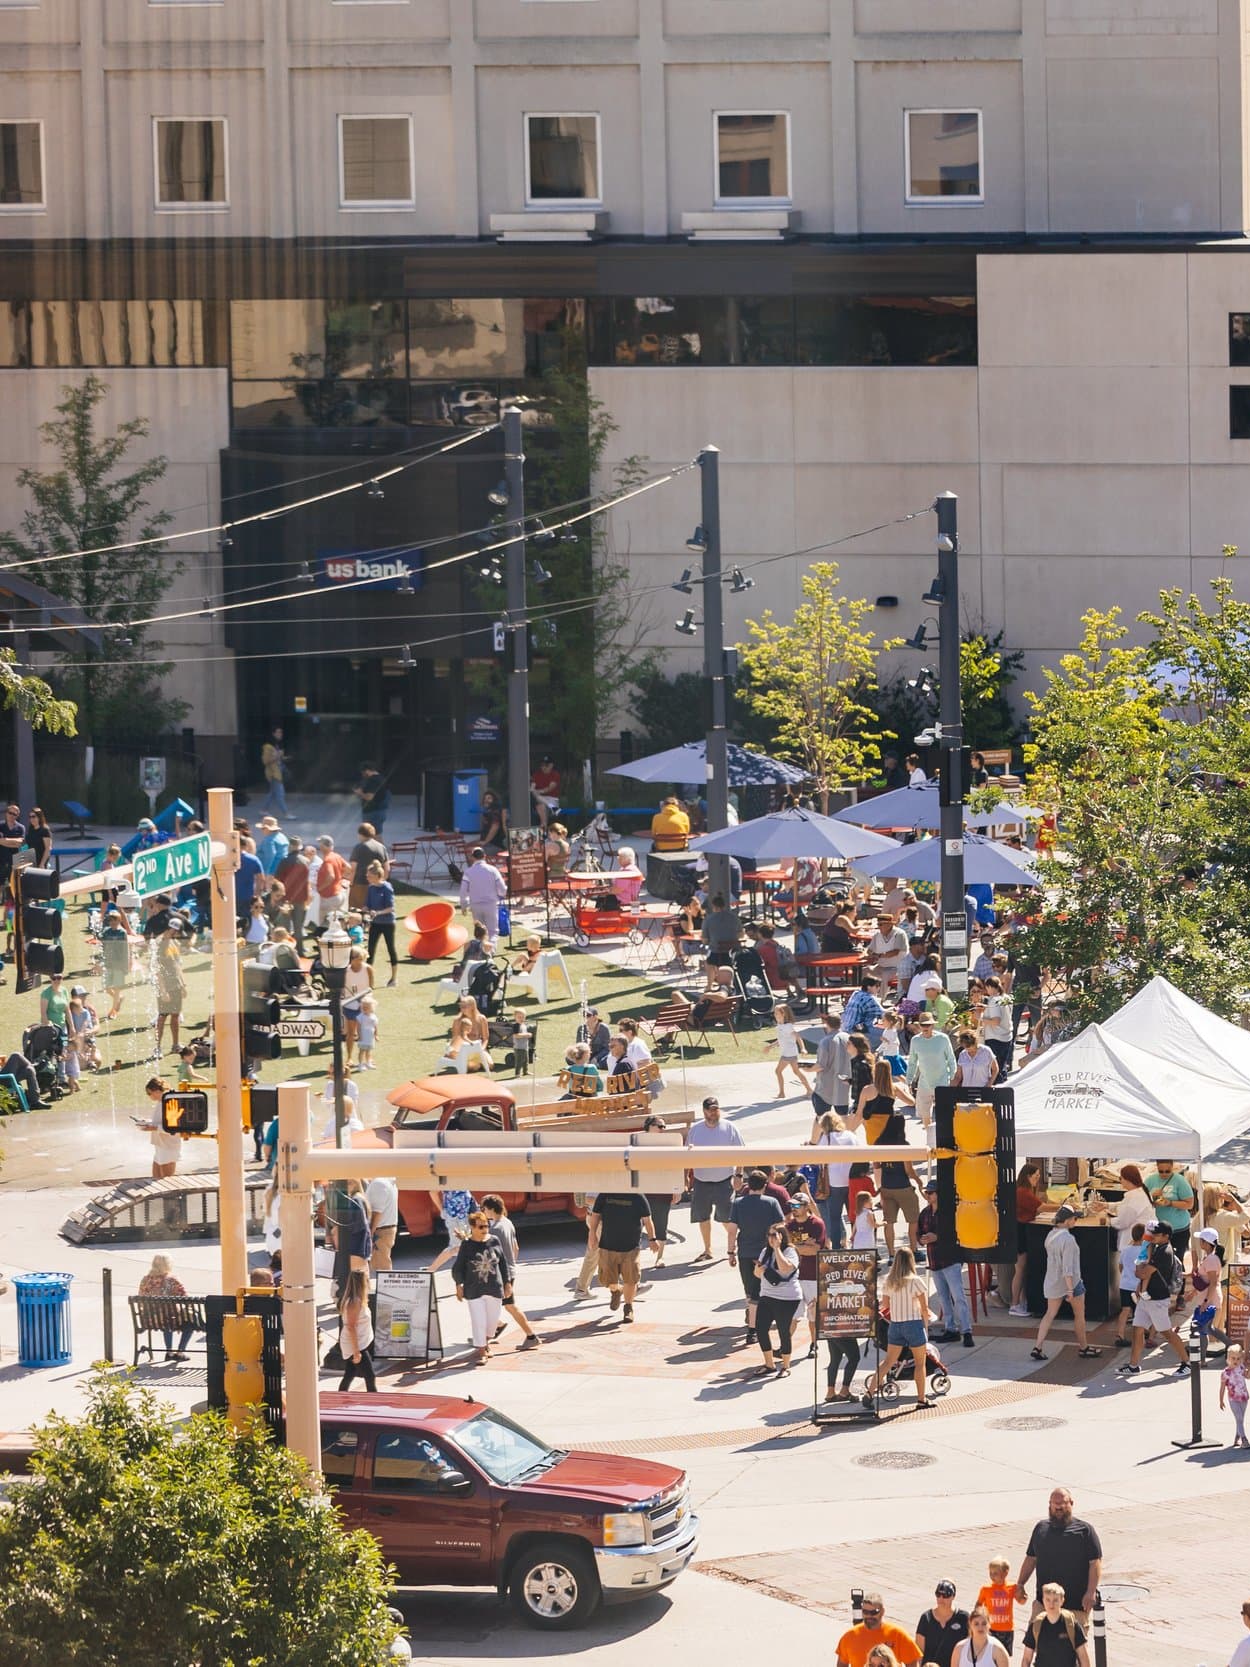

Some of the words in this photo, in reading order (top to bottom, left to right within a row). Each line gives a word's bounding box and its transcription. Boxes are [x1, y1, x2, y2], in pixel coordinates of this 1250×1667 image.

[136, 858, 157, 891] 2ND
[165, 852, 193, 882] Ave
[198, 840, 208, 870] N
[557, 1069, 598, 1095] RED
[606, 1062, 660, 1095] RIVER
[1050, 1072, 1072, 1083] RED
[1044, 1097, 1104, 1110] MARKET
[822, 1253, 871, 1264] WELCOME
[825, 1270, 841, 1283] RED
[842, 1269, 868, 1281] RIVER
[826, 1295, 868, 1310] MARKET
[1231, 1303, 1250, 1312] Info
